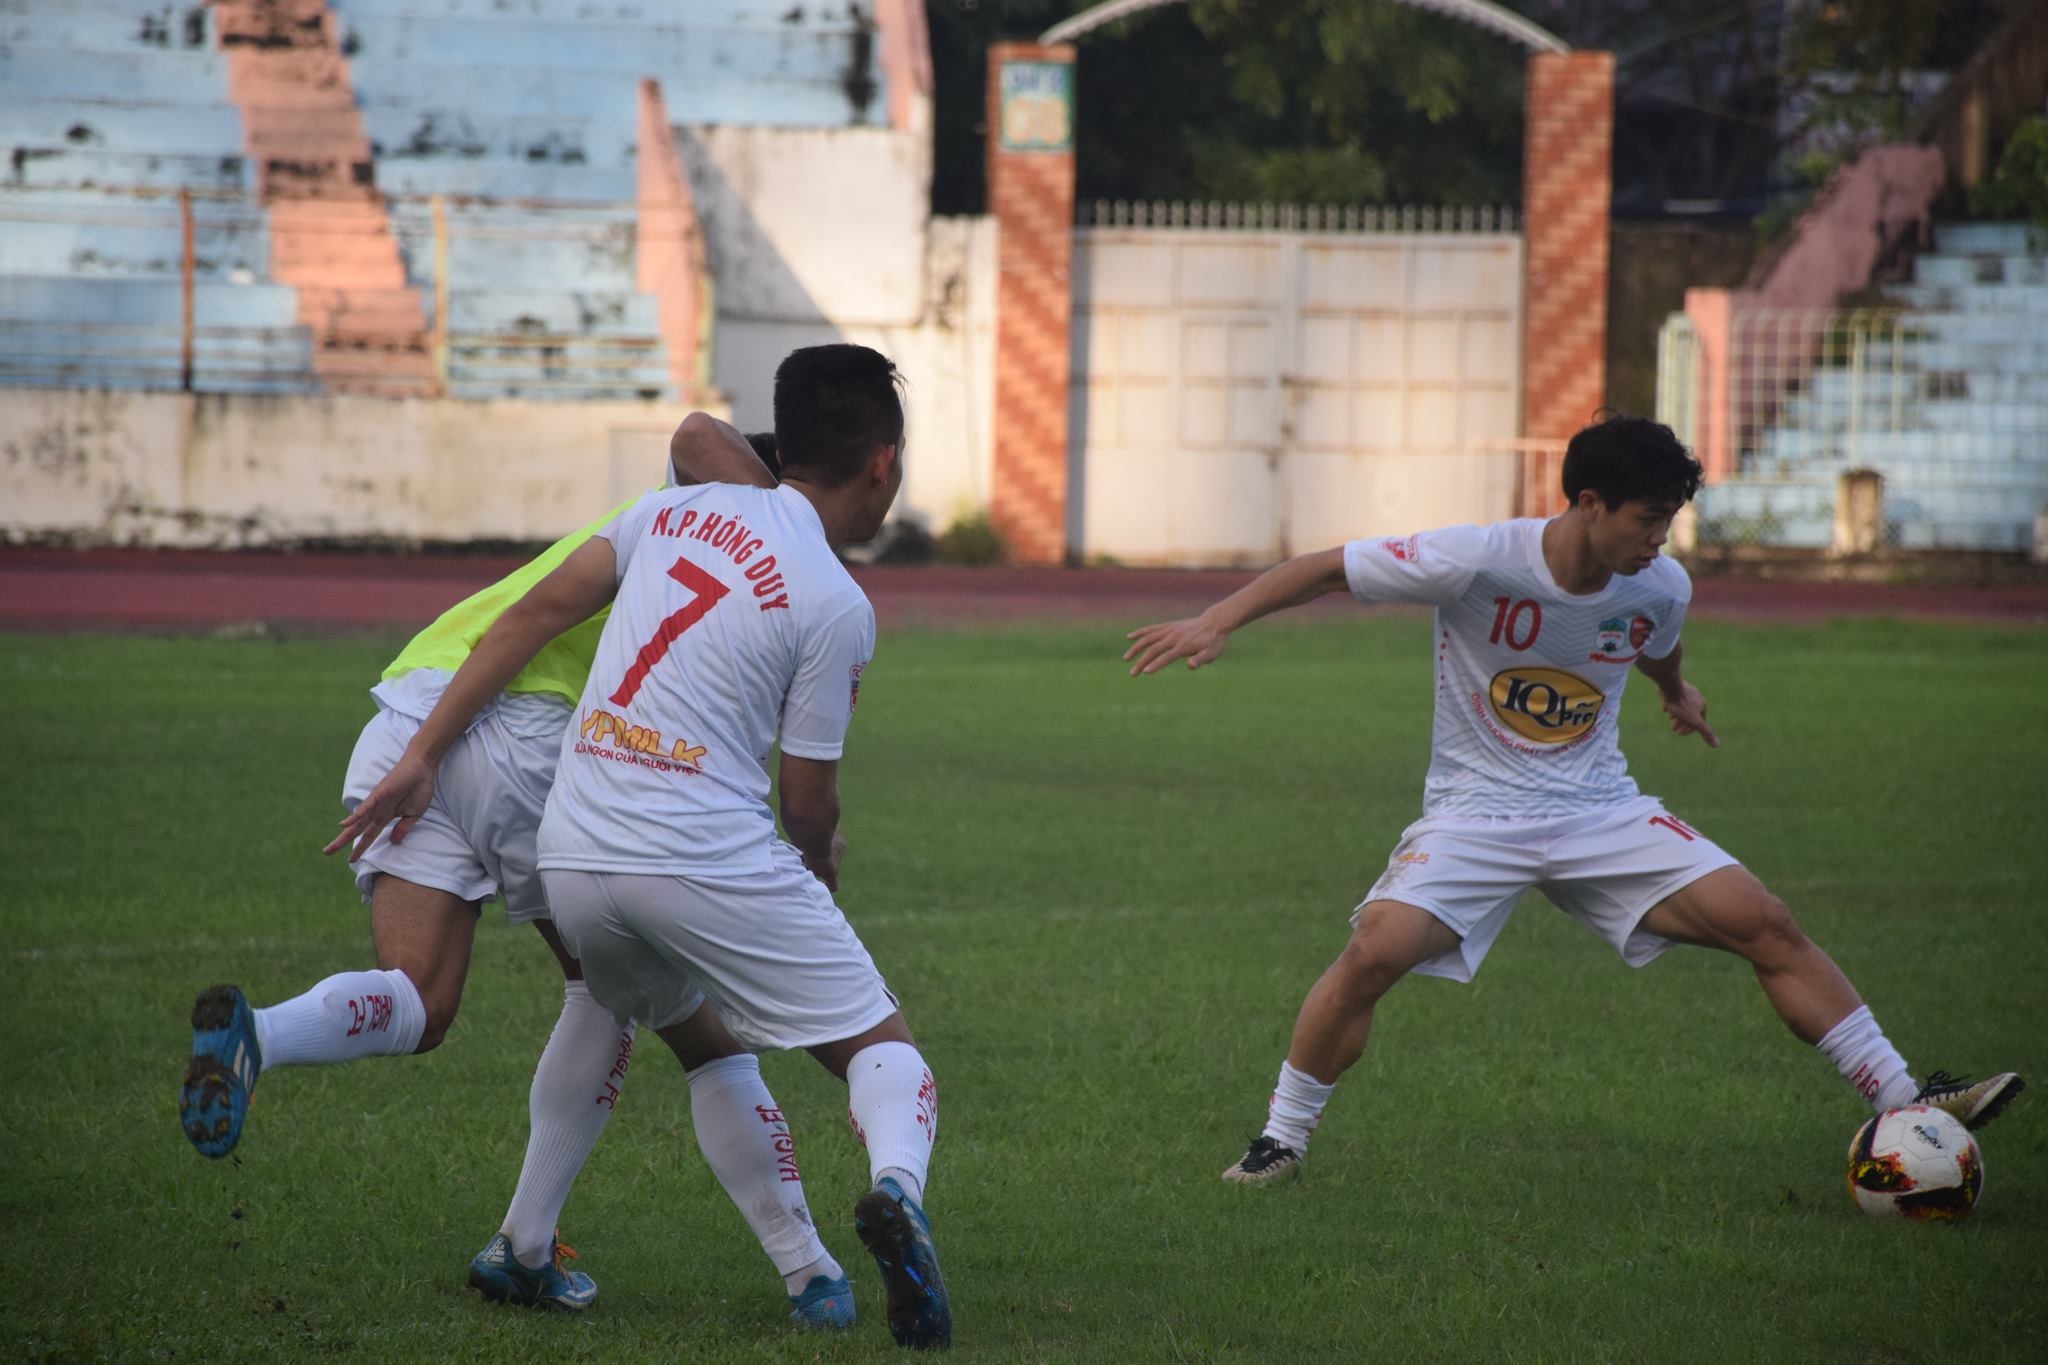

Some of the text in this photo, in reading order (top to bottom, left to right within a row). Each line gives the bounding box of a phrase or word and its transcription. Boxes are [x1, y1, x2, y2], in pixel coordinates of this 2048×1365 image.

[744, 555, 789, 612] DUY
[608, 556, 731, 708] 7
[1490, 597, 1541, 652] 10
[1500, 677, 1561, 728] IQ
[347, 995, 366, 1037] FC
[595, 1031, 633, 1110] HAGL FC
